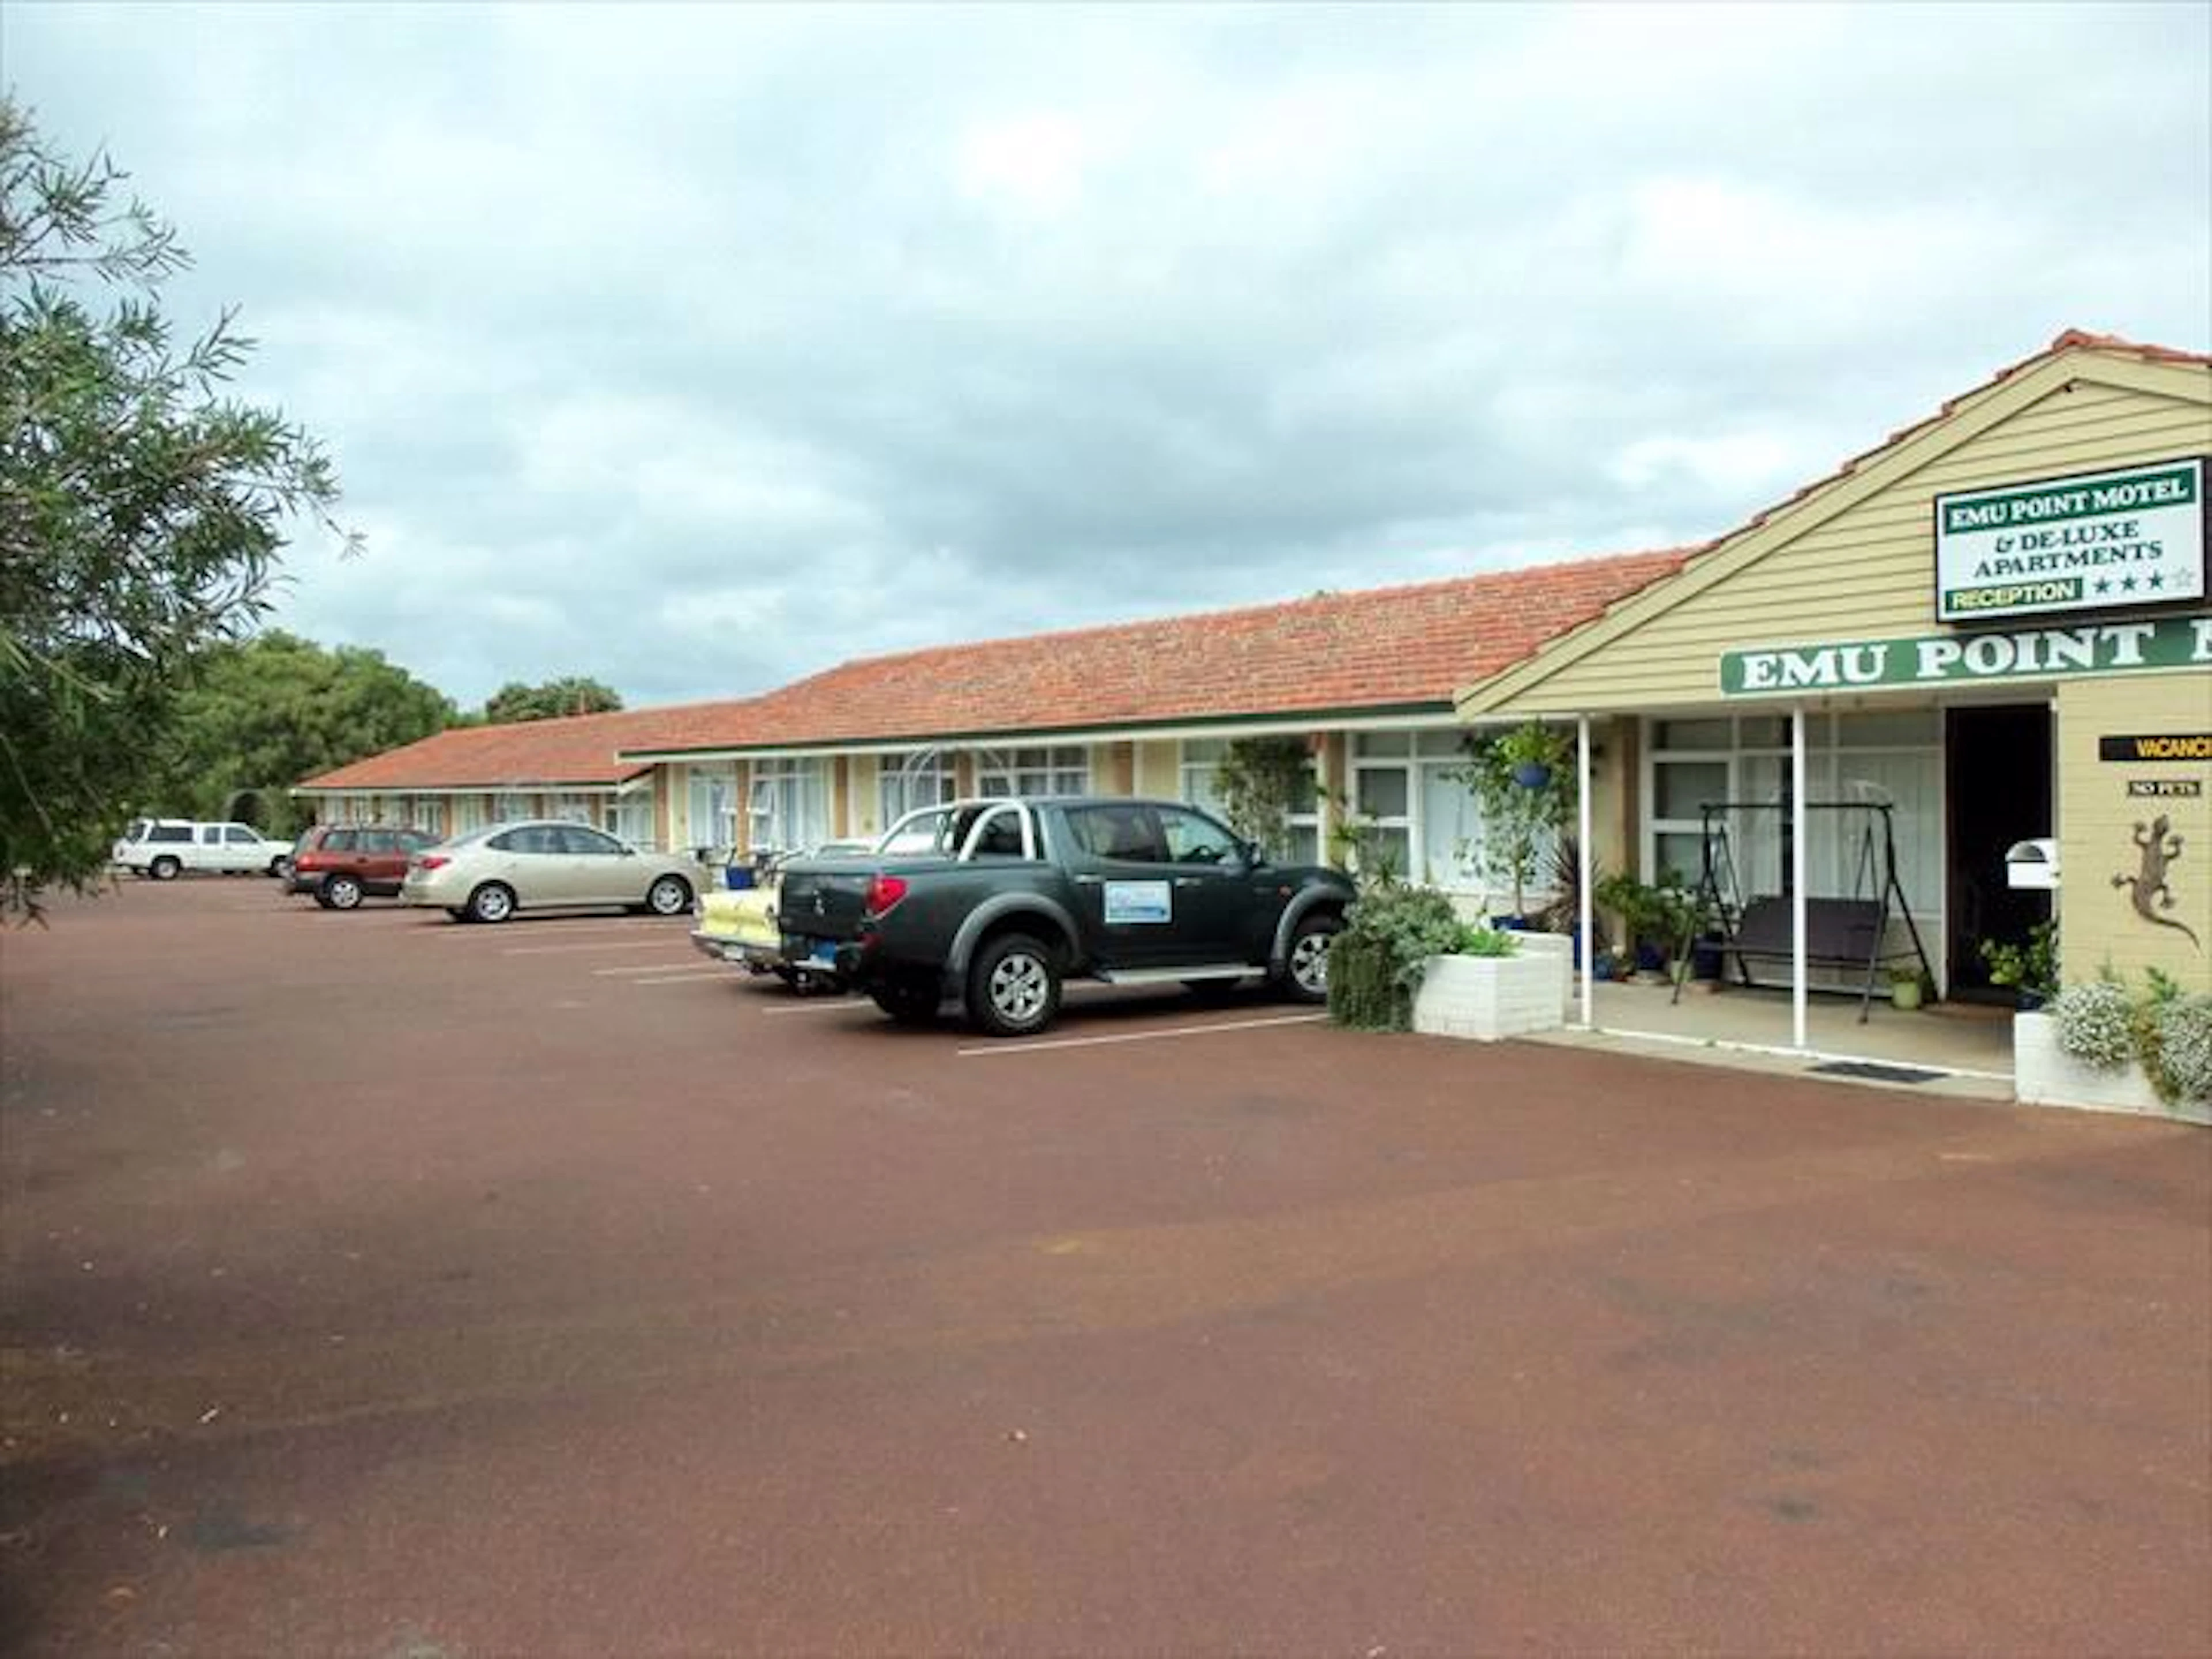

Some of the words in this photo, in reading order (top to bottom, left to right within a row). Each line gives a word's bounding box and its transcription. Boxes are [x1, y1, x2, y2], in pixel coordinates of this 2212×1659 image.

[1950, 504, 2007, 529] EMU
[2012, 492, 2089, 520] POINT
[2093, 479, 2188, 507] MOTEL
[1975, 540, 2163, 578] APARTMENTS
[1995, 535, 2014, 553] &
[1952, 581, 2074, 609] RECEPTION
[1741, 644, 1889, 690] EMU
[1916, 623, 2155, 678] POINT
[2133, 782, 2156, 794] NO
